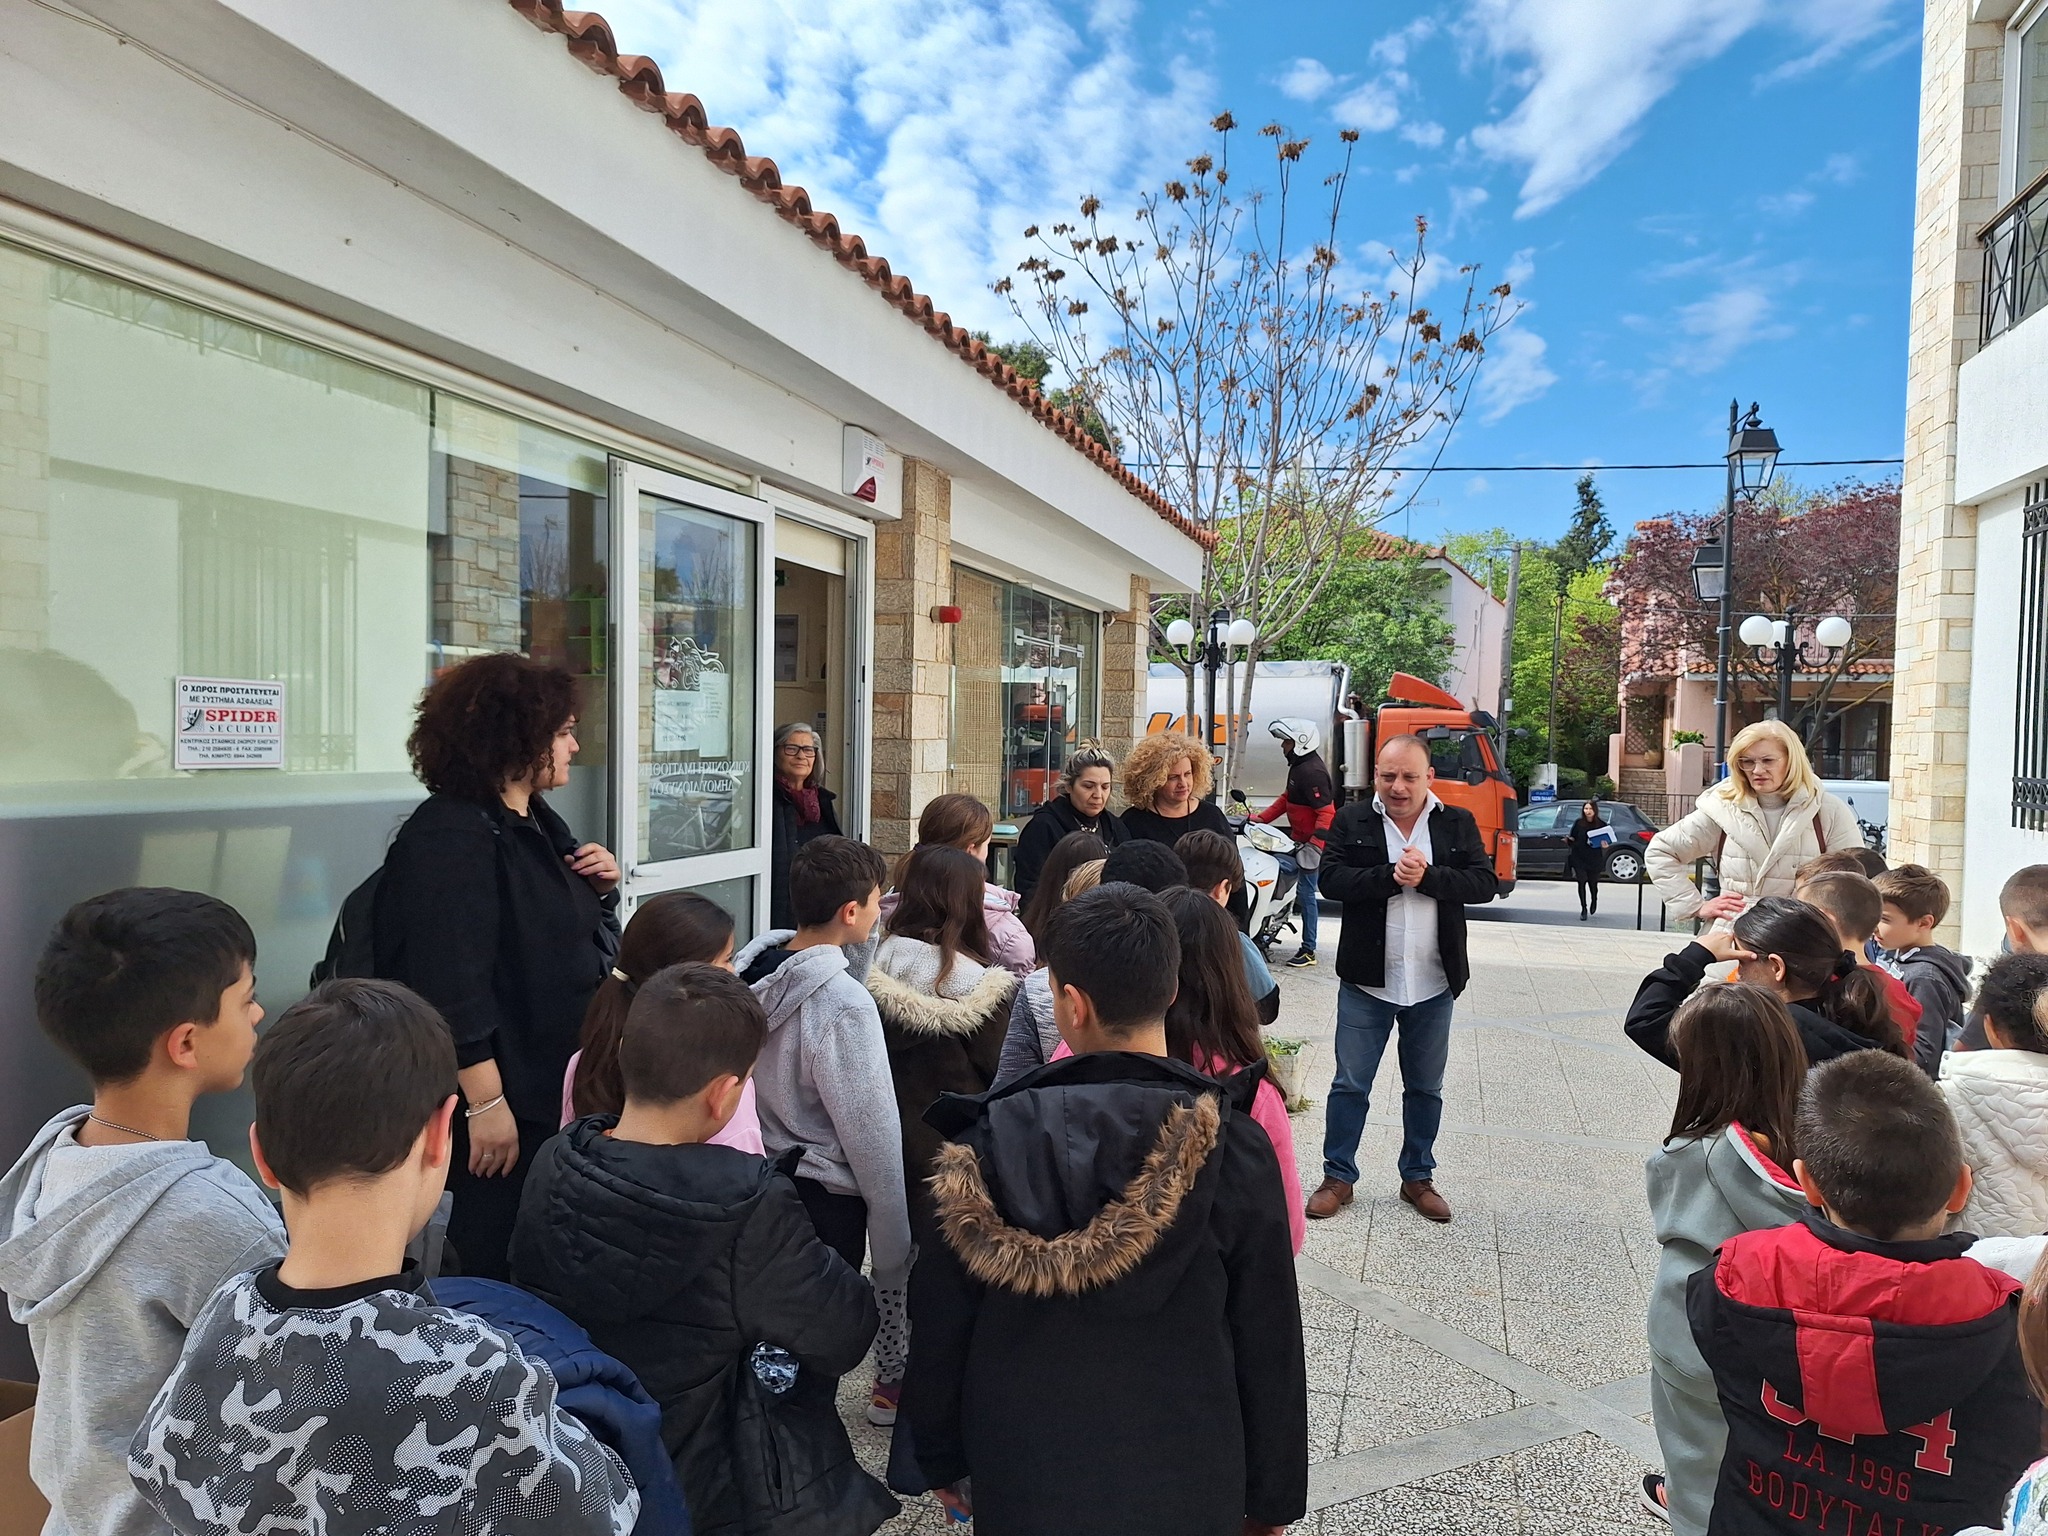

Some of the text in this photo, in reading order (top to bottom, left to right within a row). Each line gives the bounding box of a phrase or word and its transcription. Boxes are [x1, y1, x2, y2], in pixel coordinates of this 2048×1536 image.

[191, 685, 218, 693] ΧΩΡΟΣ
[220, 687, 280, 696] ΠΡΟΣΤΑΤΕΥΕΤΑΙ
[202, 696, 235, 704] ΣΥΣΤΗΜΑ
[236, 697, 273, 705] ΑΣΦΑΛΕΙΑΣ
[205, 709, 277, 723] SPIDER
[209, 725, 273, 734] SECURITY
[1845, 1453, 1912, 1502] 1996
